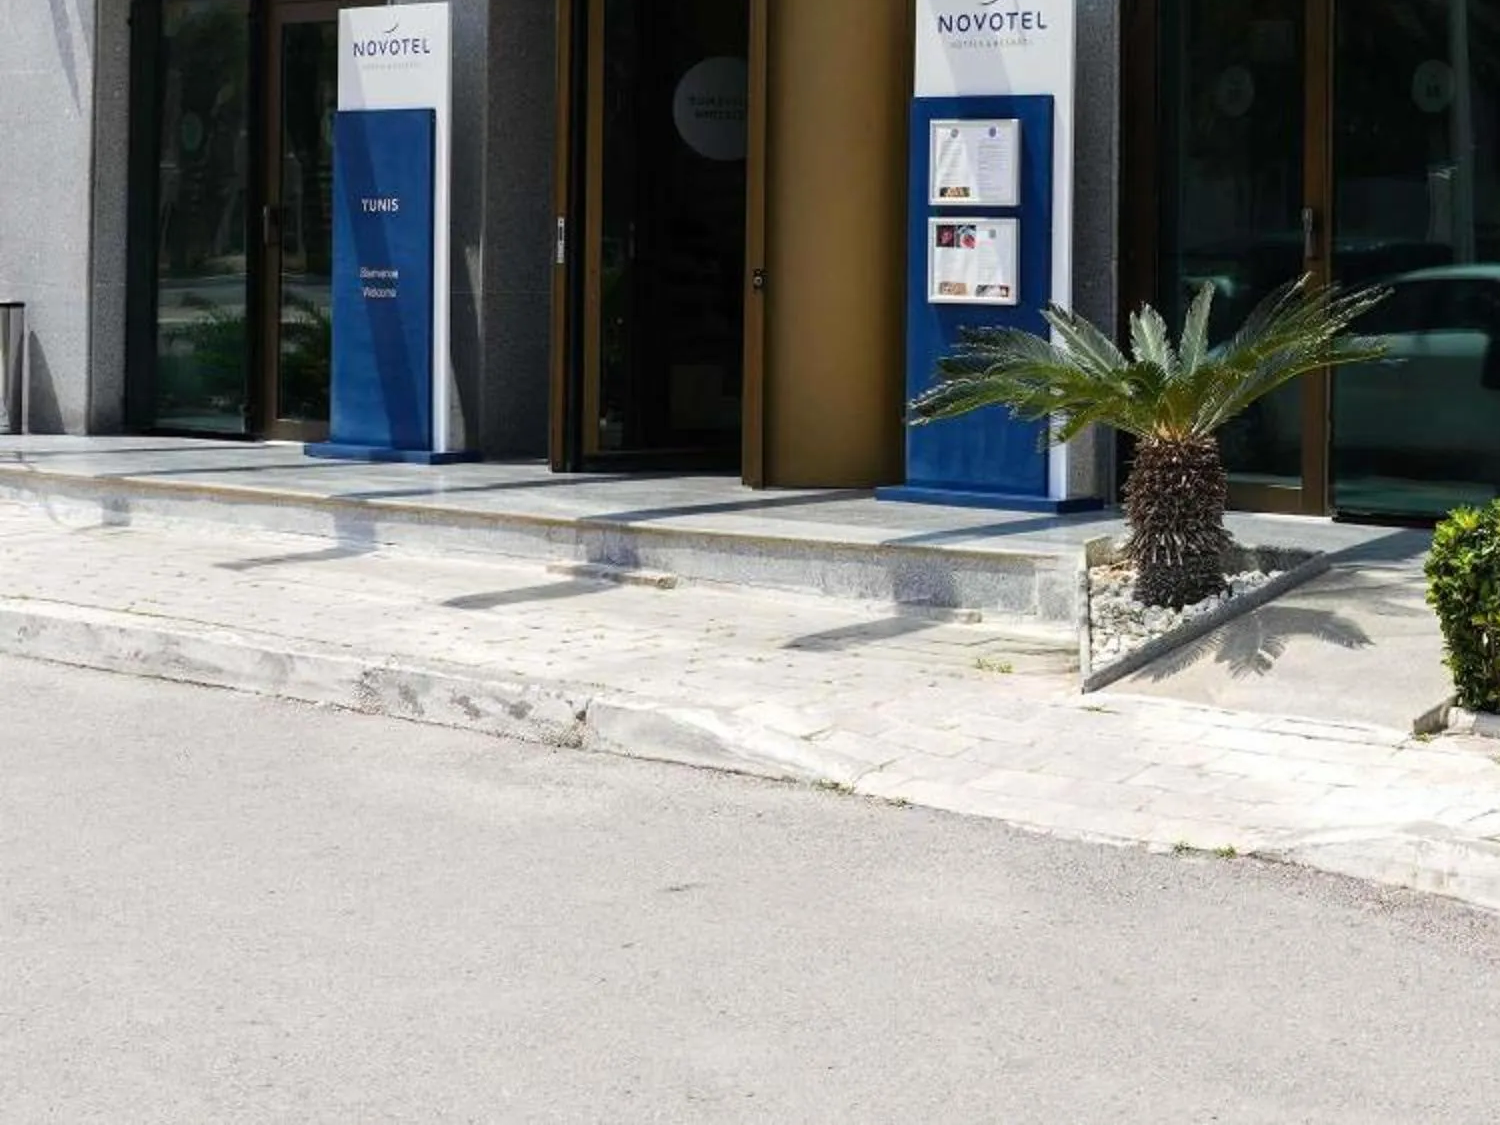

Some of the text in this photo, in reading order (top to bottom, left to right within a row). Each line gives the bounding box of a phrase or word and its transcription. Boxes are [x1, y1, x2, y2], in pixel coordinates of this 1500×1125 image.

[938, 11, 1048, 34] NOVOTEL
[353, 38, 431, 58] NOVOTEL
[361, 199, 399, 213] TUNIS
